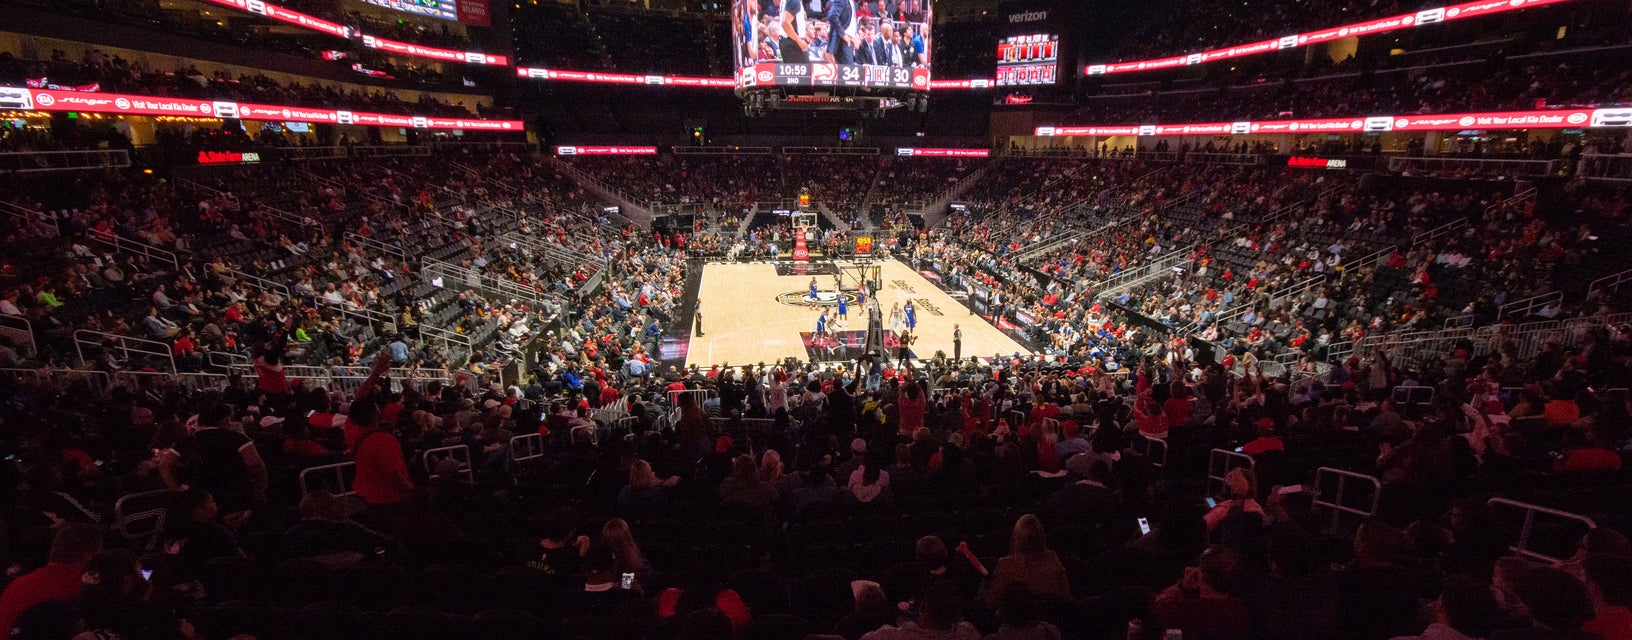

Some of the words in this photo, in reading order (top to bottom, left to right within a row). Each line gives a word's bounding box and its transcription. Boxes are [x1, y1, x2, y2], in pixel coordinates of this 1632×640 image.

[1009, 10, 1046, 23] verizon
[780, 66, 806, 75] 10:59
[842, 66, 859, 80] 34
[894, 69, 909, 82] 30
[58, 98, 112, 106] stinger
[132, 100, 146, 109] Visit
[146, 101, 158, 110] Your
[158, 102, 173, 110] Local
[242, 153, 260, 161] ARENA
